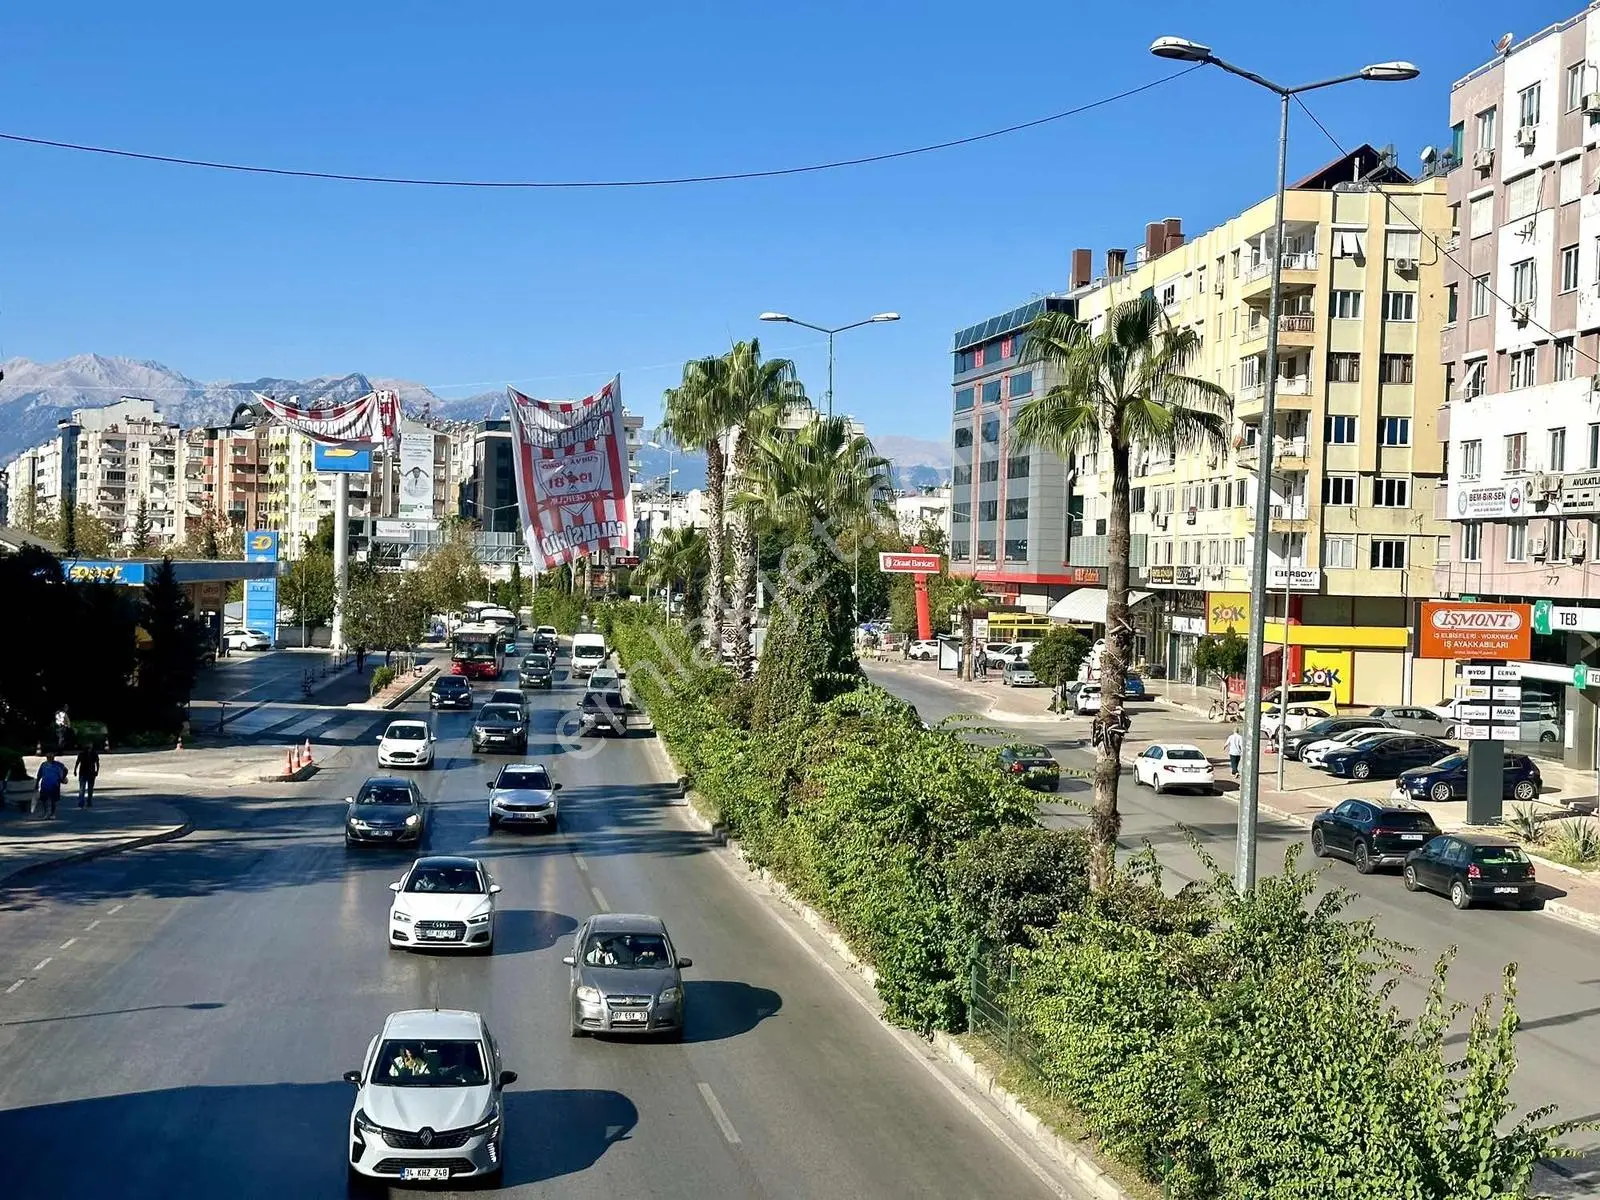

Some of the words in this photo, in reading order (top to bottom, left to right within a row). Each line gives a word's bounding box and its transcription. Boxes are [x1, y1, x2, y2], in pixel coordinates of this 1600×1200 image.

[1559, 612, 1578, 626] TEB
[405, 1168, 414, 1177] 34
[417, 1168, 431, 1177] KHZ
[433, 1168, 448, 1177] 248
